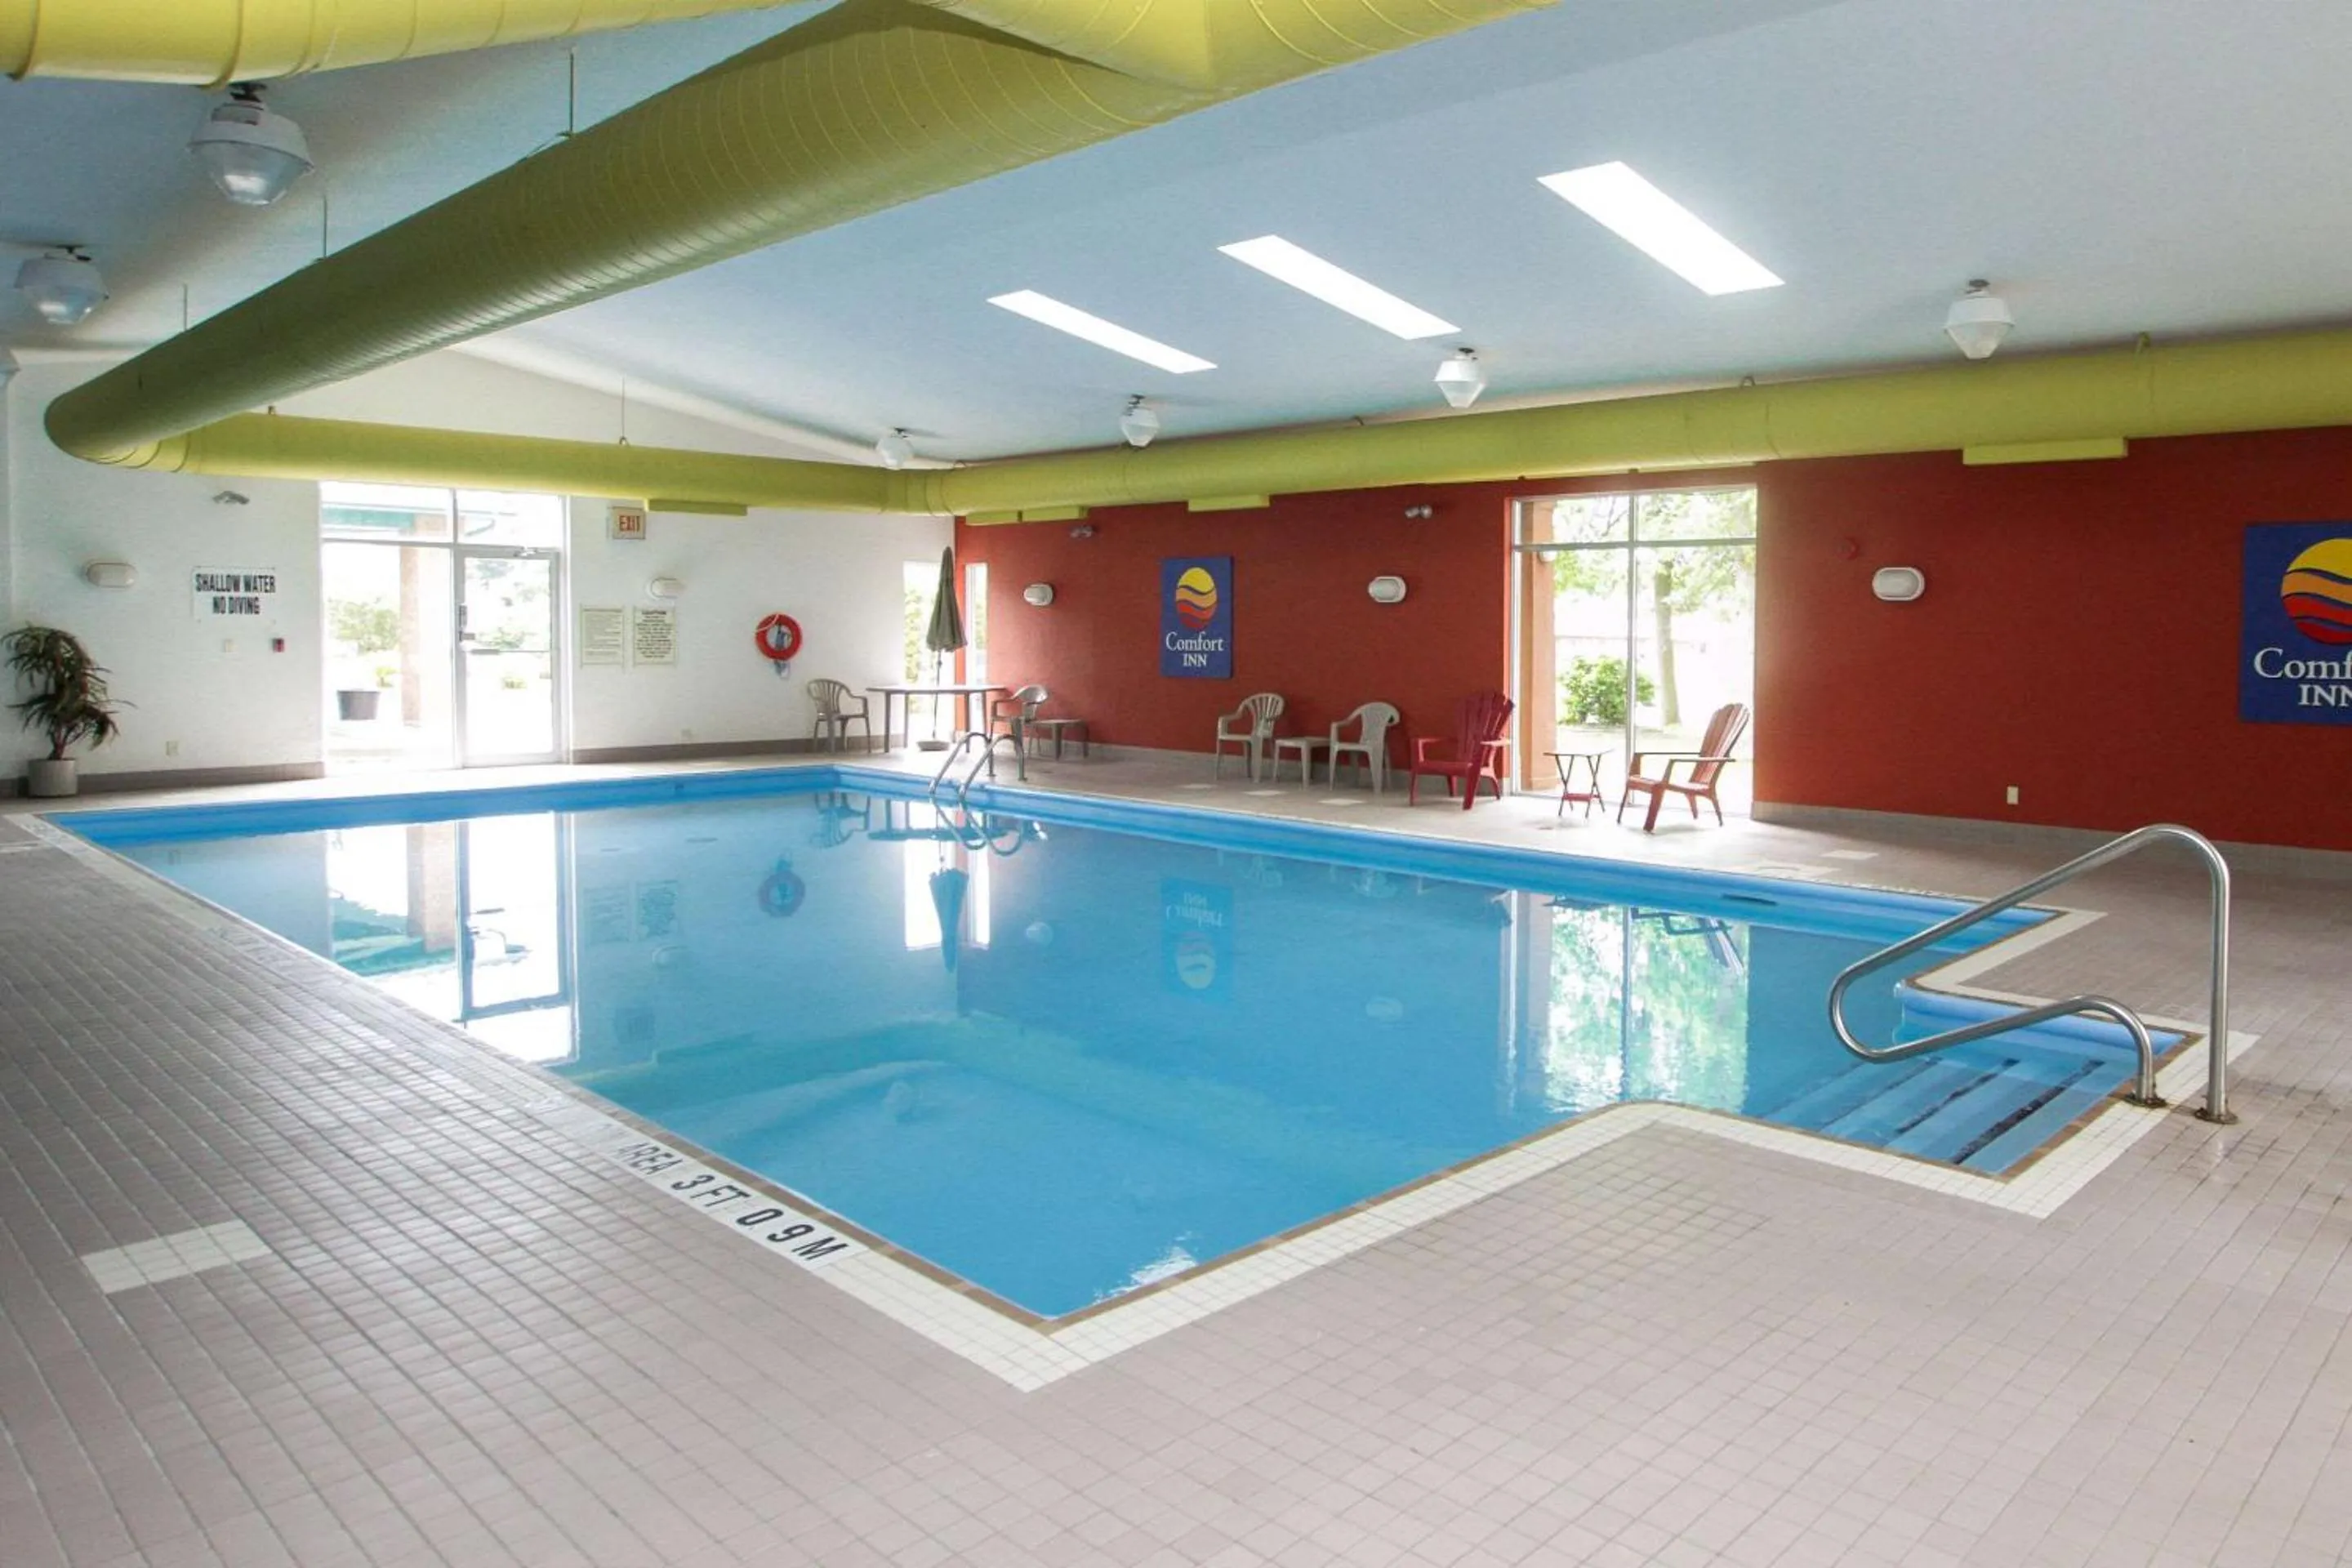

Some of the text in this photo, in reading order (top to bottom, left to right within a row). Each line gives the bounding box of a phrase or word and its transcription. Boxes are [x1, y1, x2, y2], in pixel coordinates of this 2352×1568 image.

[196, 573, 275, 593] SHALLOW WATER
[213, 596, 260, 614] NO DIVING
[1166, 630, 1224, 651] Comfort
[1183, 653, 1207, 667] INN
[2297, 684, 2352, 706] INN
